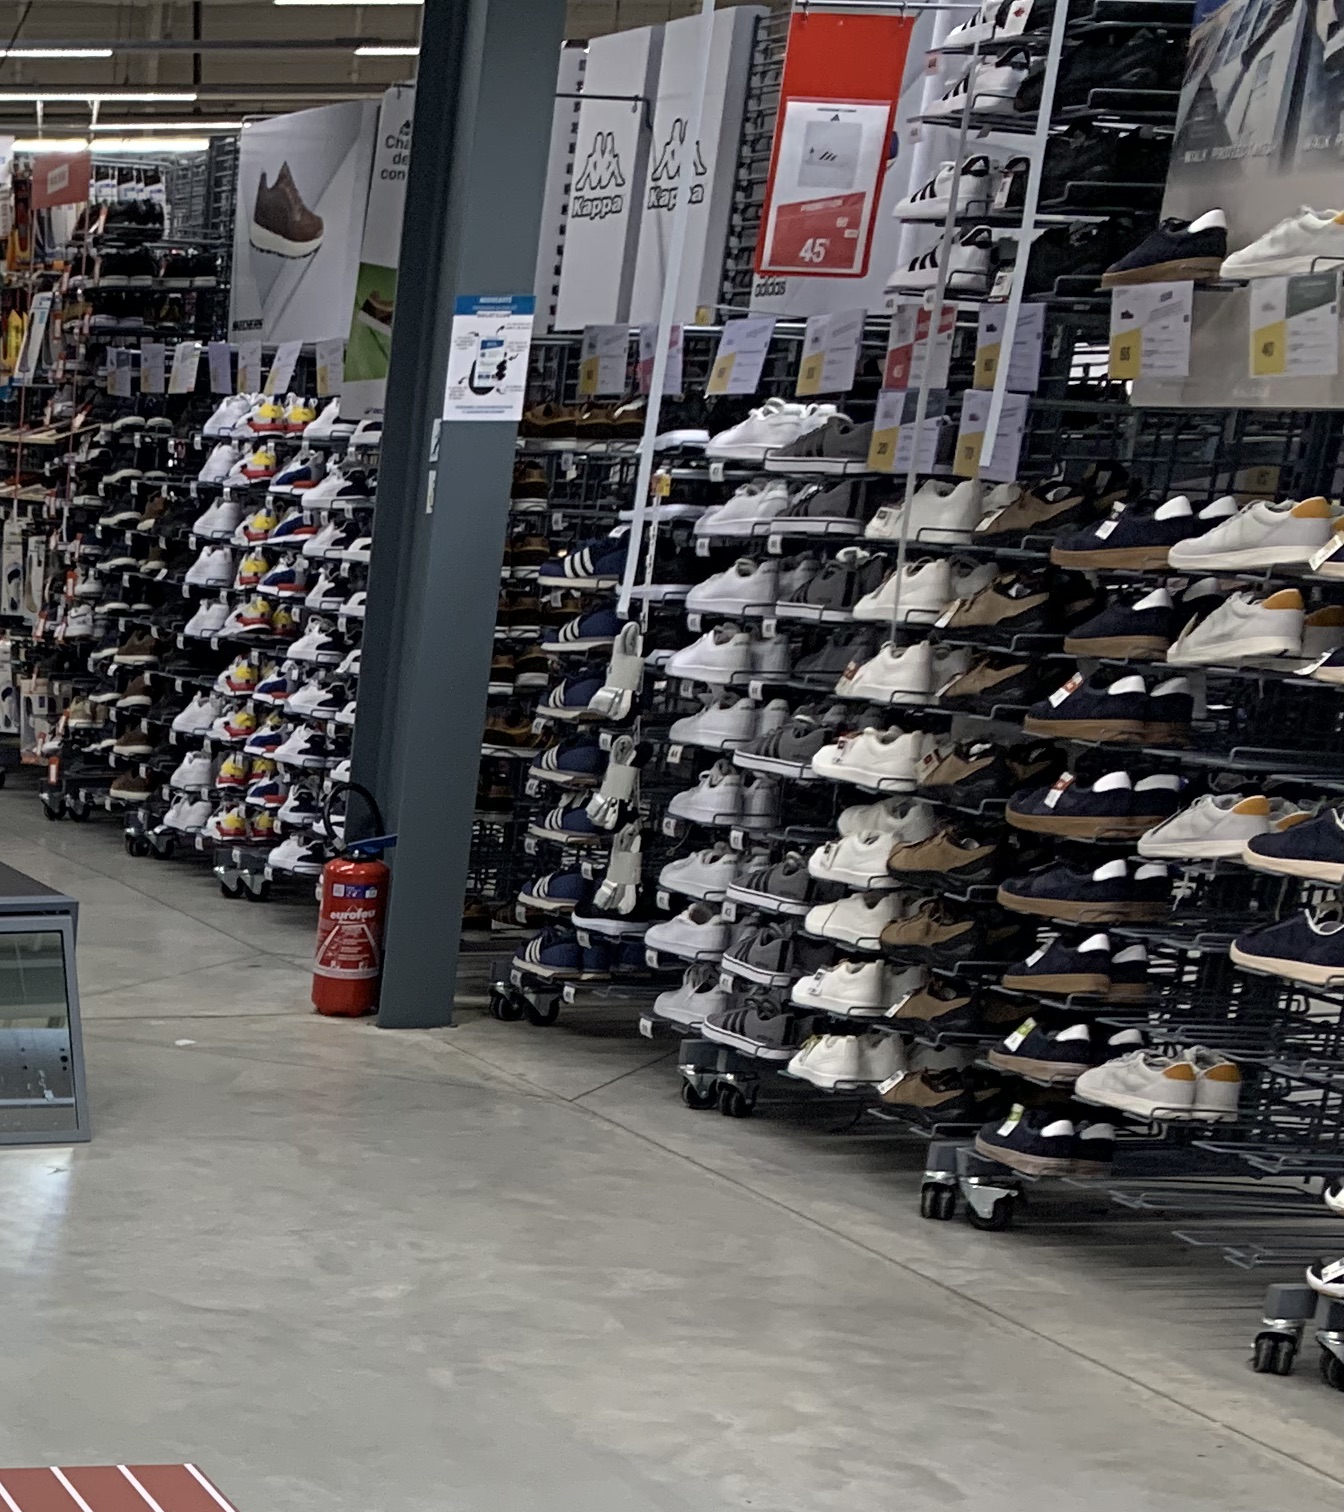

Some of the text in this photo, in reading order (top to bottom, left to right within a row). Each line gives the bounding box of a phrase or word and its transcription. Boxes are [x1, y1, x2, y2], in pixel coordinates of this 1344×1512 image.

[571, 195, 624, 220] Kappa
[647, 184, 705, 211] Kapa
[330, 907, 376, 921] eurofeu
